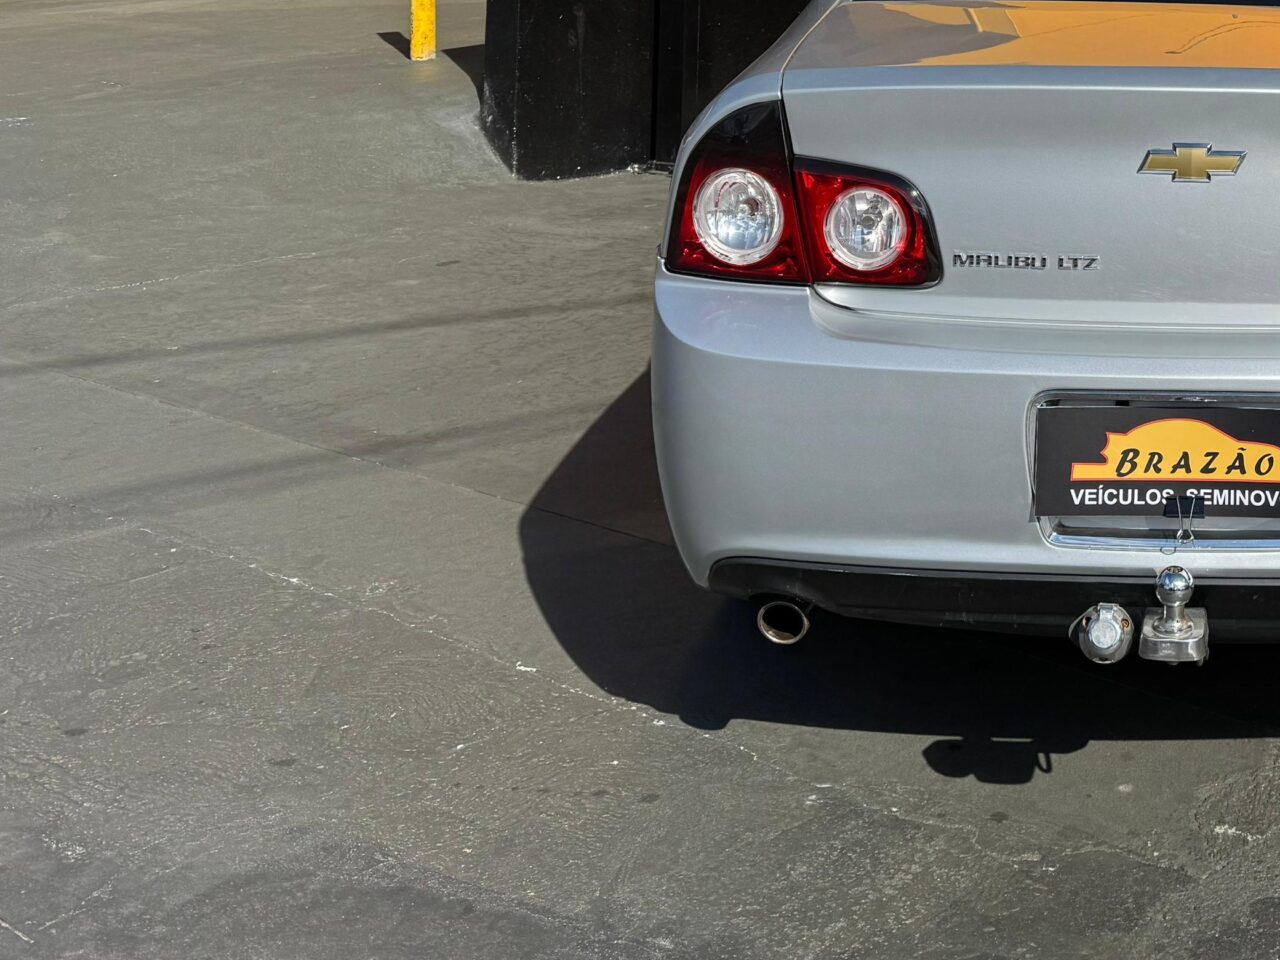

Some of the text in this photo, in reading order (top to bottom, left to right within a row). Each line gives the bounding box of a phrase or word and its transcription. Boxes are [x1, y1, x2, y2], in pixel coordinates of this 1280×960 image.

[953, 251, 1100, 271] MALIBU LTZ
[1115, 447, 1275, 478] BRAZÃO
[1070, 485, 1175, 507] VEÍCULOS
